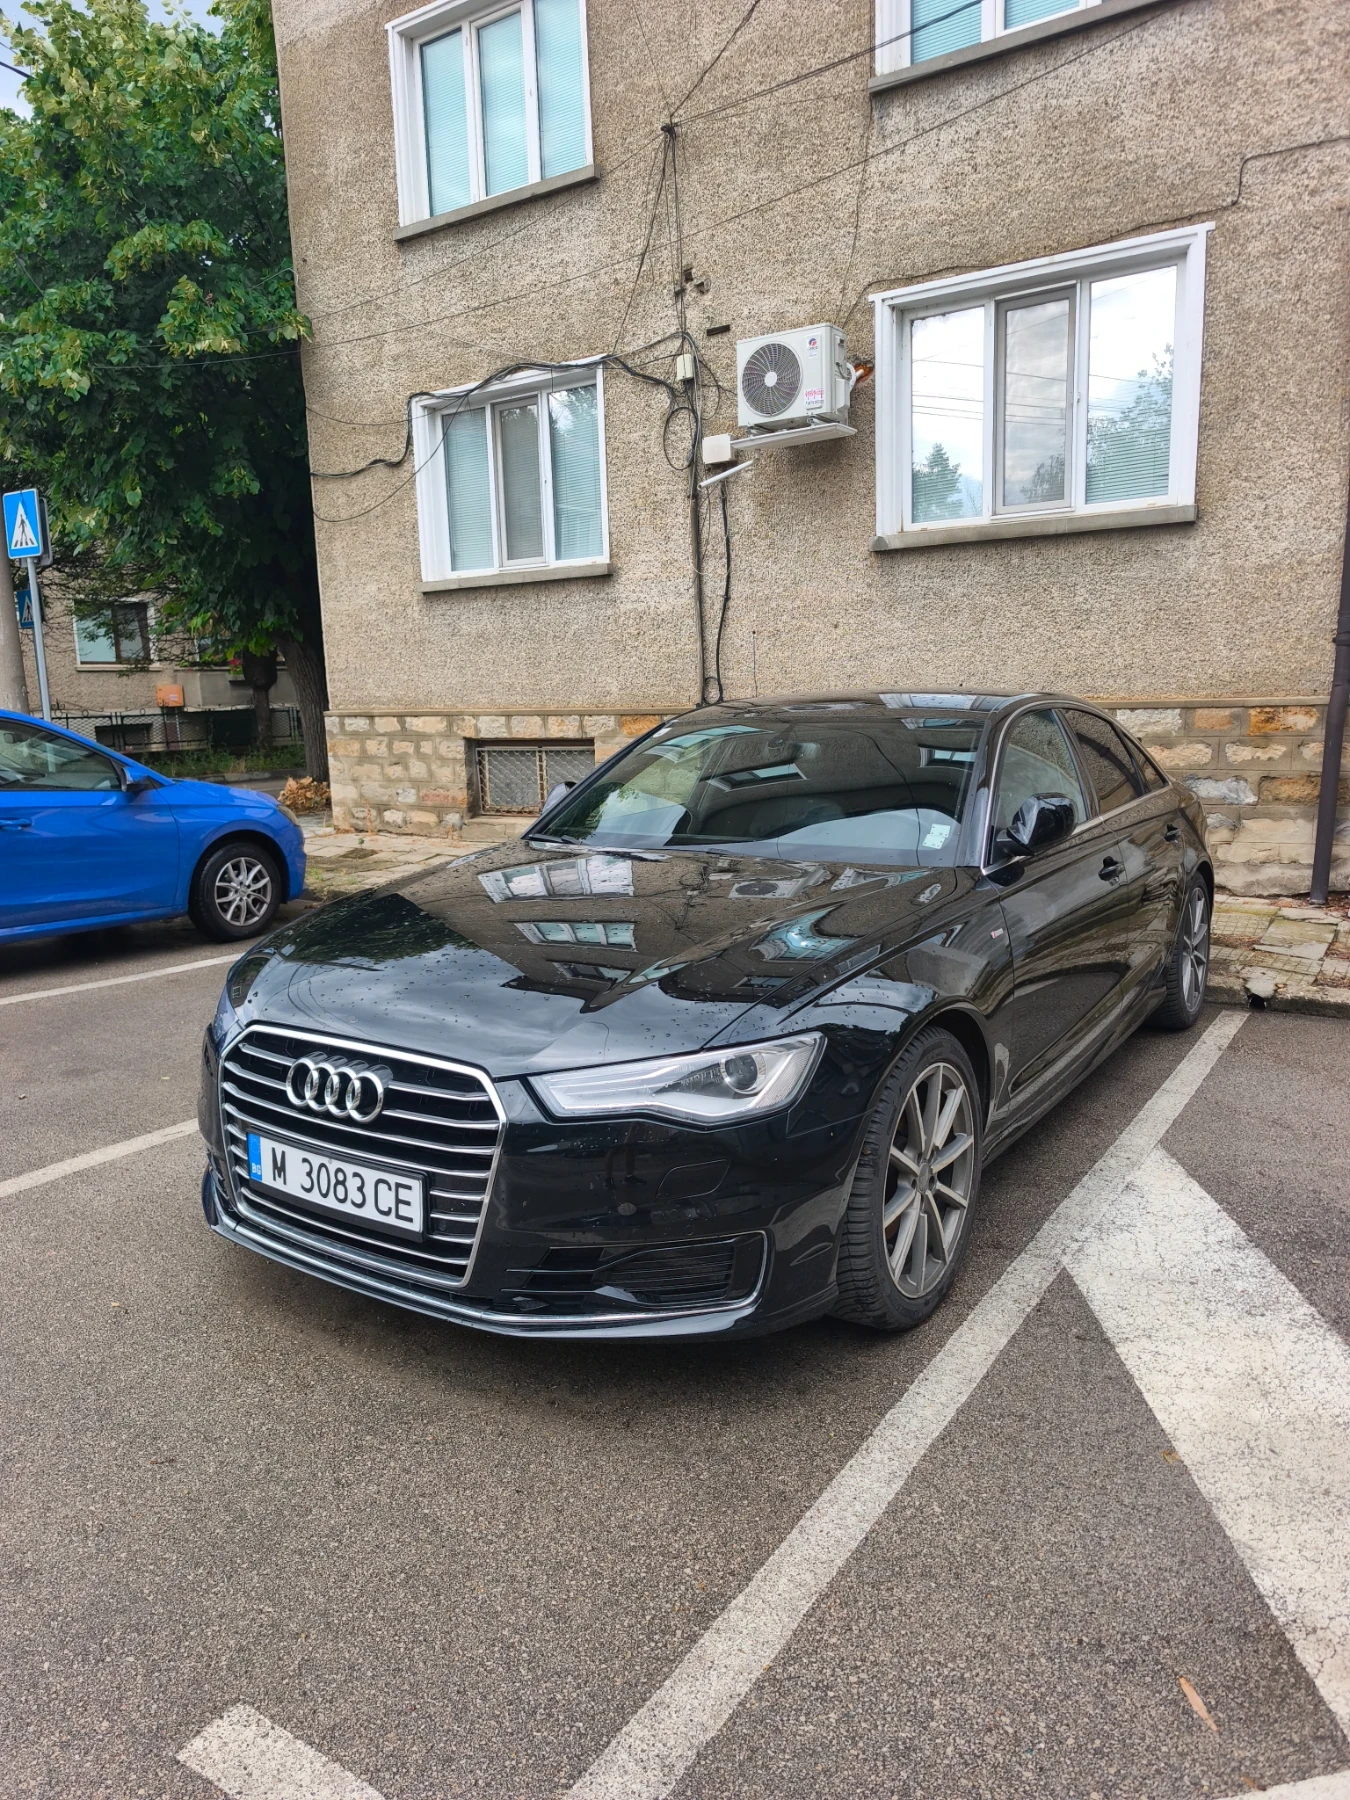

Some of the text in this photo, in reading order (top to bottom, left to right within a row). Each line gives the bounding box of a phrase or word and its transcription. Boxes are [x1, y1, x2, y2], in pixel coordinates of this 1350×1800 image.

[251, 1163, 261, 1175] BG
[271, 1147, 413, 1223] M 3083 CE
